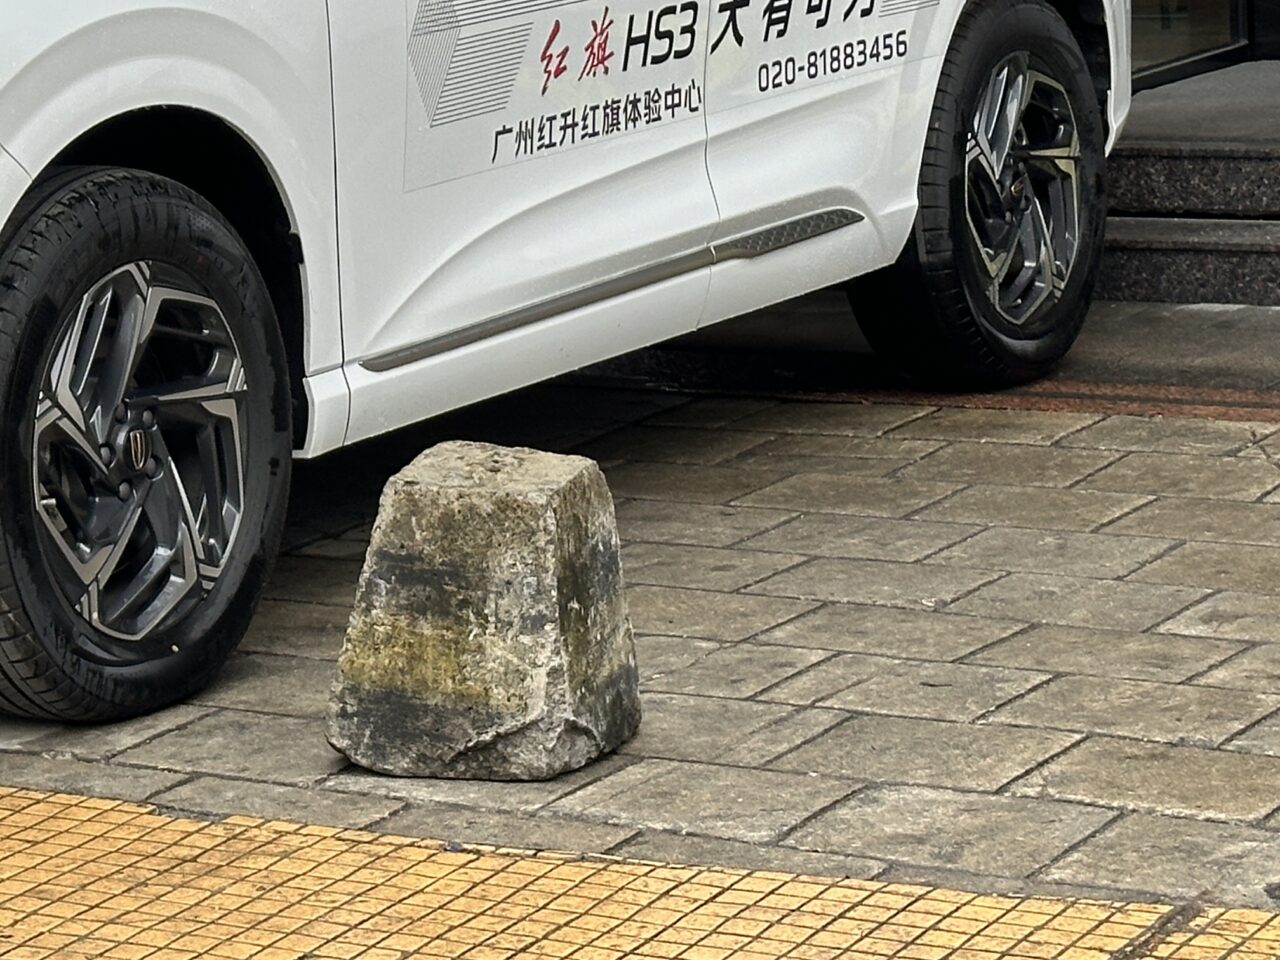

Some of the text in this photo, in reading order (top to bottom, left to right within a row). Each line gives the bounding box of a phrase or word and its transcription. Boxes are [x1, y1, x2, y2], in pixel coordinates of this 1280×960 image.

[540, 6, 615, 96] 红旗
[622, 1, 699, 72] HS3
[758, 29, 909, 93] 020-81883456
[491, 78, 703, 164] 广州红升红旗体验中心
